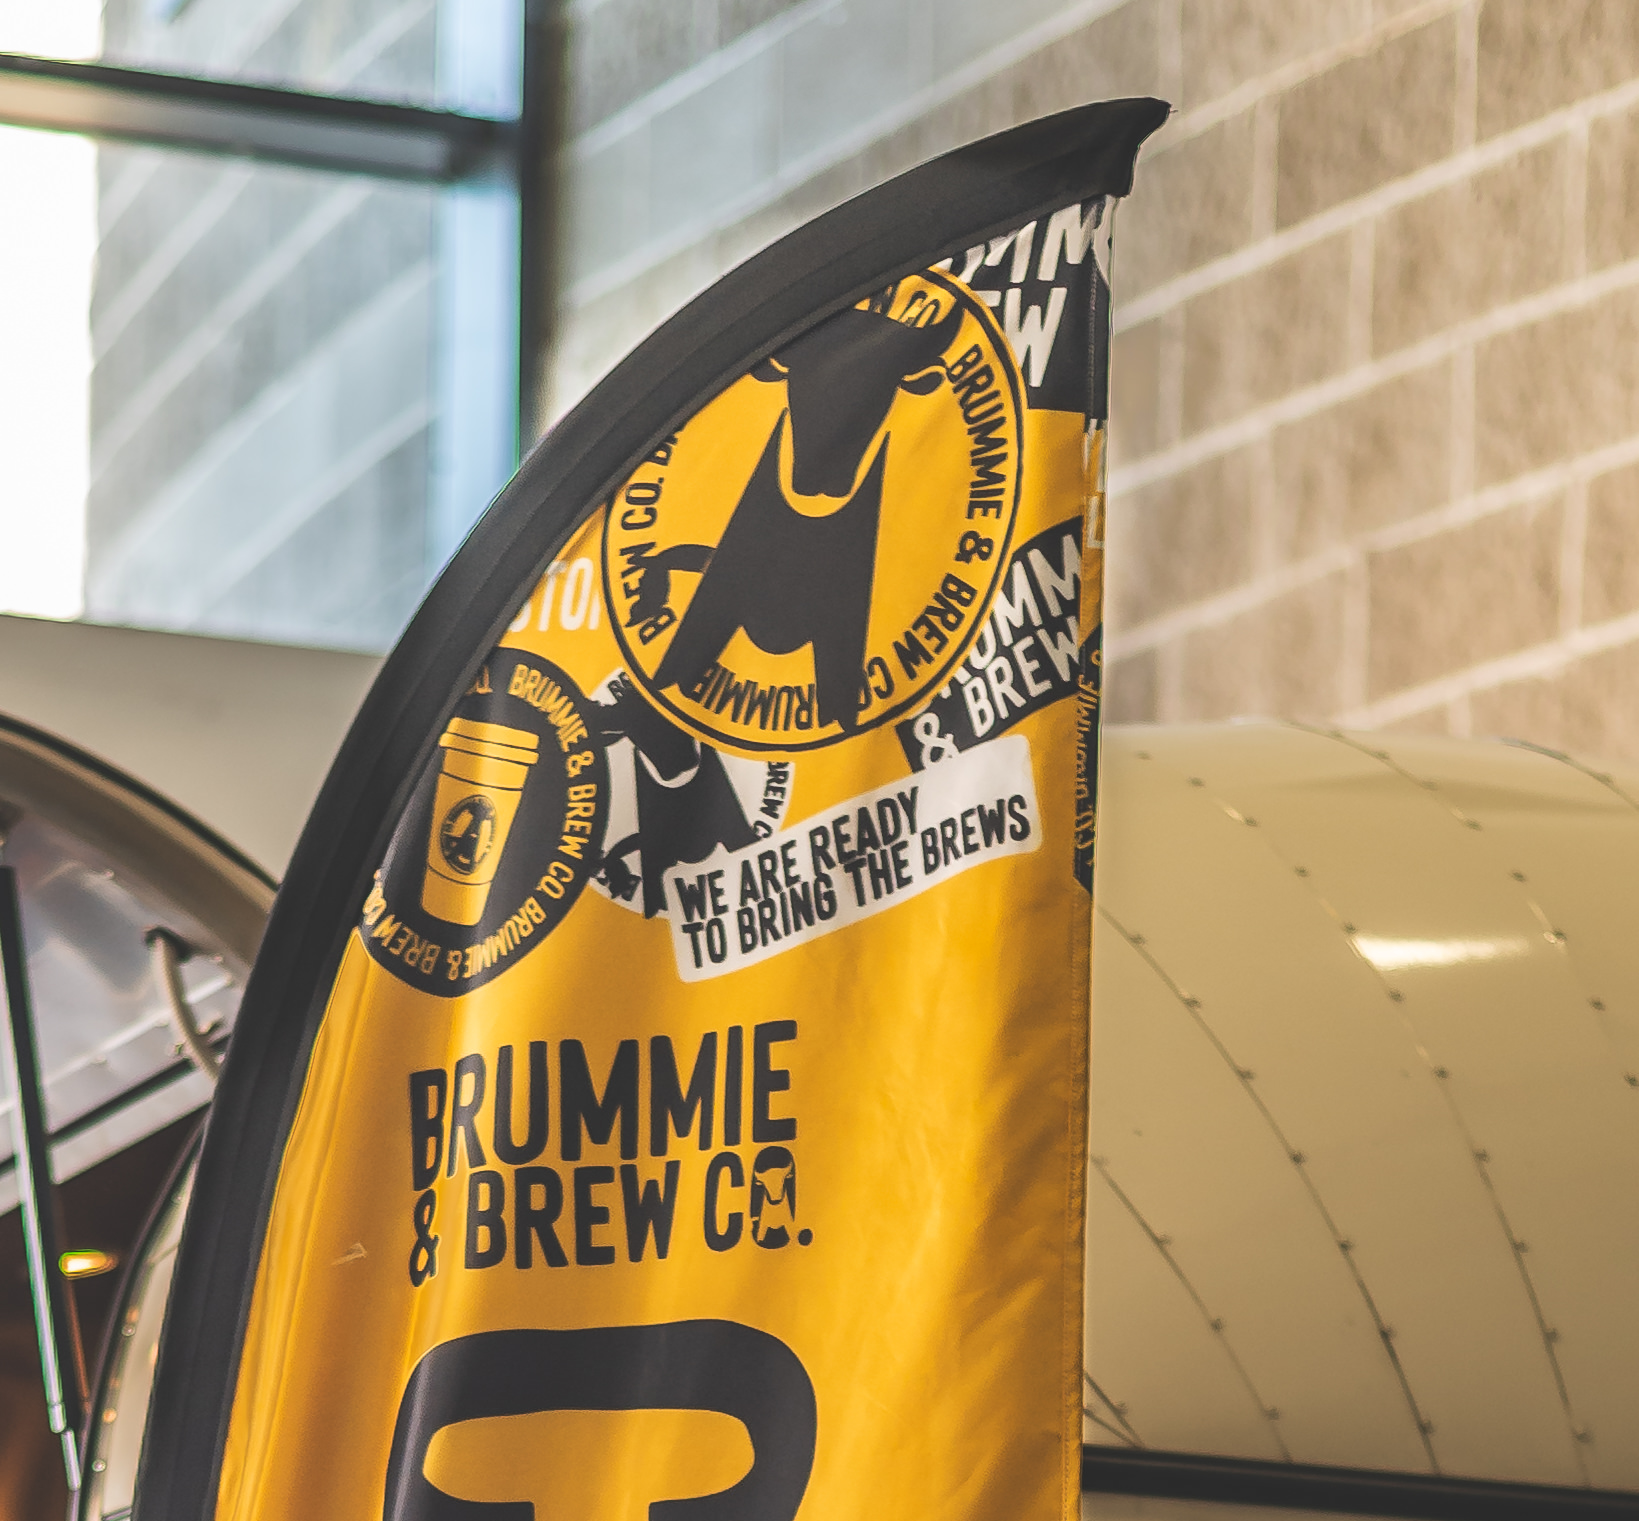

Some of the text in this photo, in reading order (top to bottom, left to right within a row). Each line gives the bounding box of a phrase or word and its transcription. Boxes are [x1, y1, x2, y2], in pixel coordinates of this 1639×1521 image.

[946, 343, 1010, 520] BRUMMIE
[621, 477, 664, 531] CO.
[955, 530, 994, 564] &
[892, 572, 978, 682] BREW
[508, 663, 589, 753] BRUMMIE
[565, 750, 595, 779] &
[557, 783, 598, 860] BREW
[674, 869, 730, 923] WE
[739, 839, 801, 907] ARE
[808, 785, 920, 873] READY
[681, 794, 1032, 969] TO BRING THE BREWS
[370, 914, 442, 976] BREW
[408, 1019, 798, 1192] BRUMMIE
[408, 1145, 814, 1288] & BREW CO.
